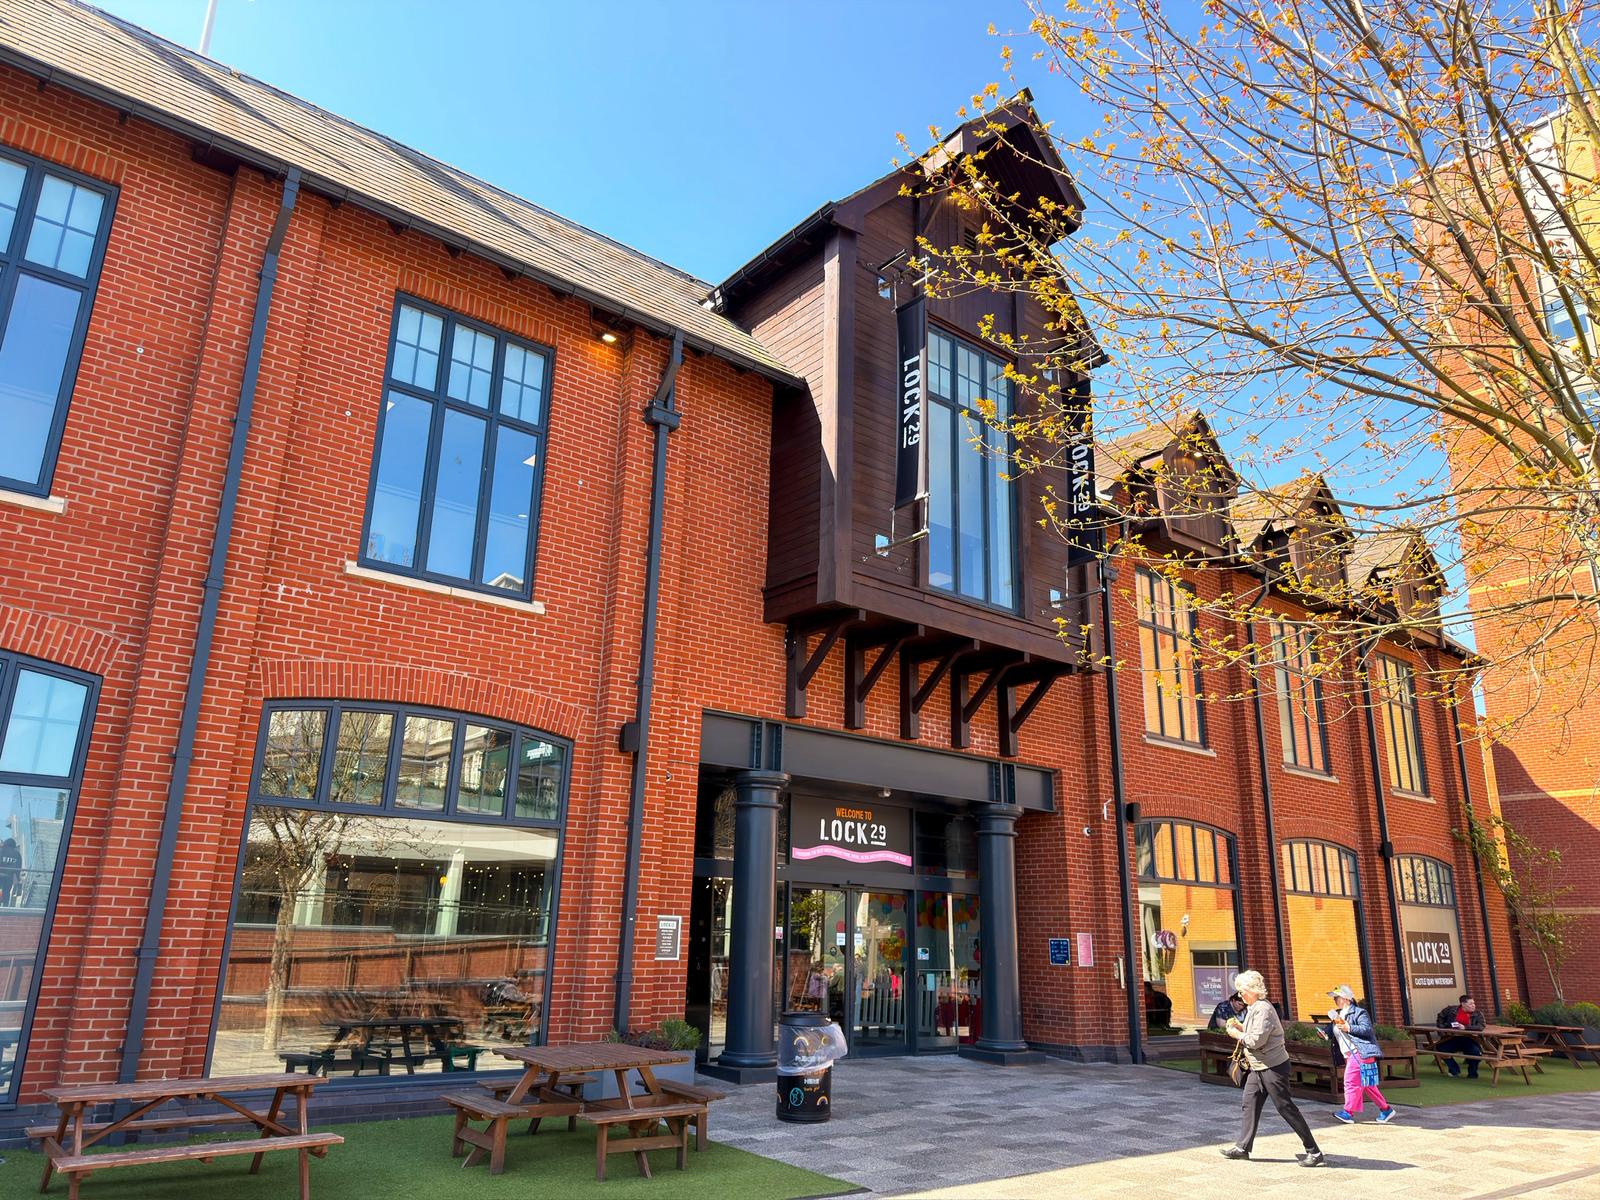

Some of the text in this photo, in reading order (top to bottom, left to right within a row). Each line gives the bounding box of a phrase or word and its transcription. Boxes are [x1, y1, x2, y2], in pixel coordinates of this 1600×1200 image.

[903, 355, 921, 449] LOCK 29
[836, 807, 872, 820] WELCOME TO
[820, 819, 887, 847] LOCK 29
[1410, 941, 1451, 964] LOCK 29
